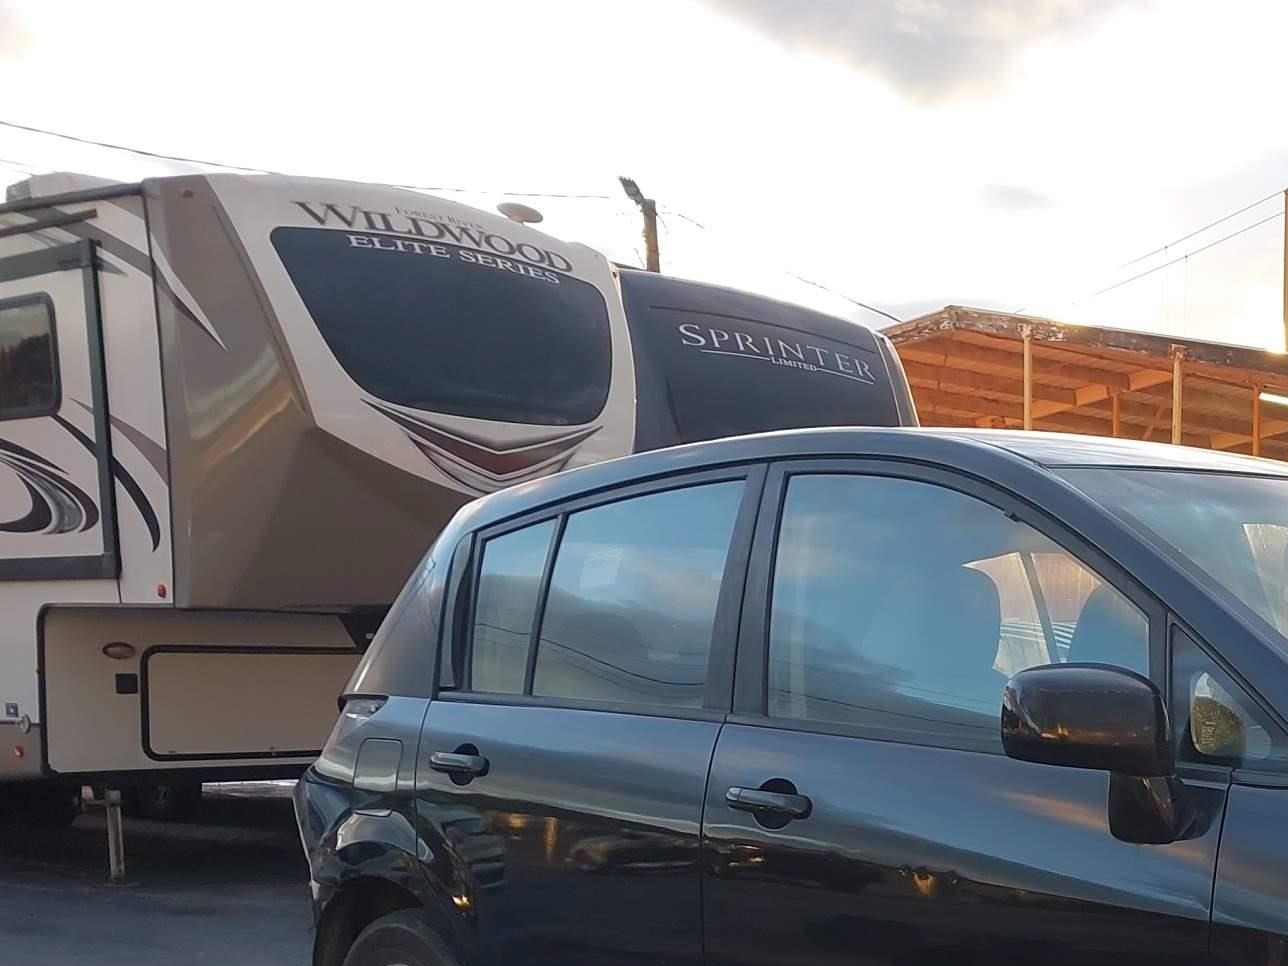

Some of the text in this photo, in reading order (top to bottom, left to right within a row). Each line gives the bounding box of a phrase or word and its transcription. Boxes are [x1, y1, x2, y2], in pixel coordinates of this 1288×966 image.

[295, 201, 573, 273] WILDWOOD
[347, 234, 561, 285] ELITE SERIES
[677, 323, 877, 381] SPRINTER
[770, 356, 818, 371] LIMITED
